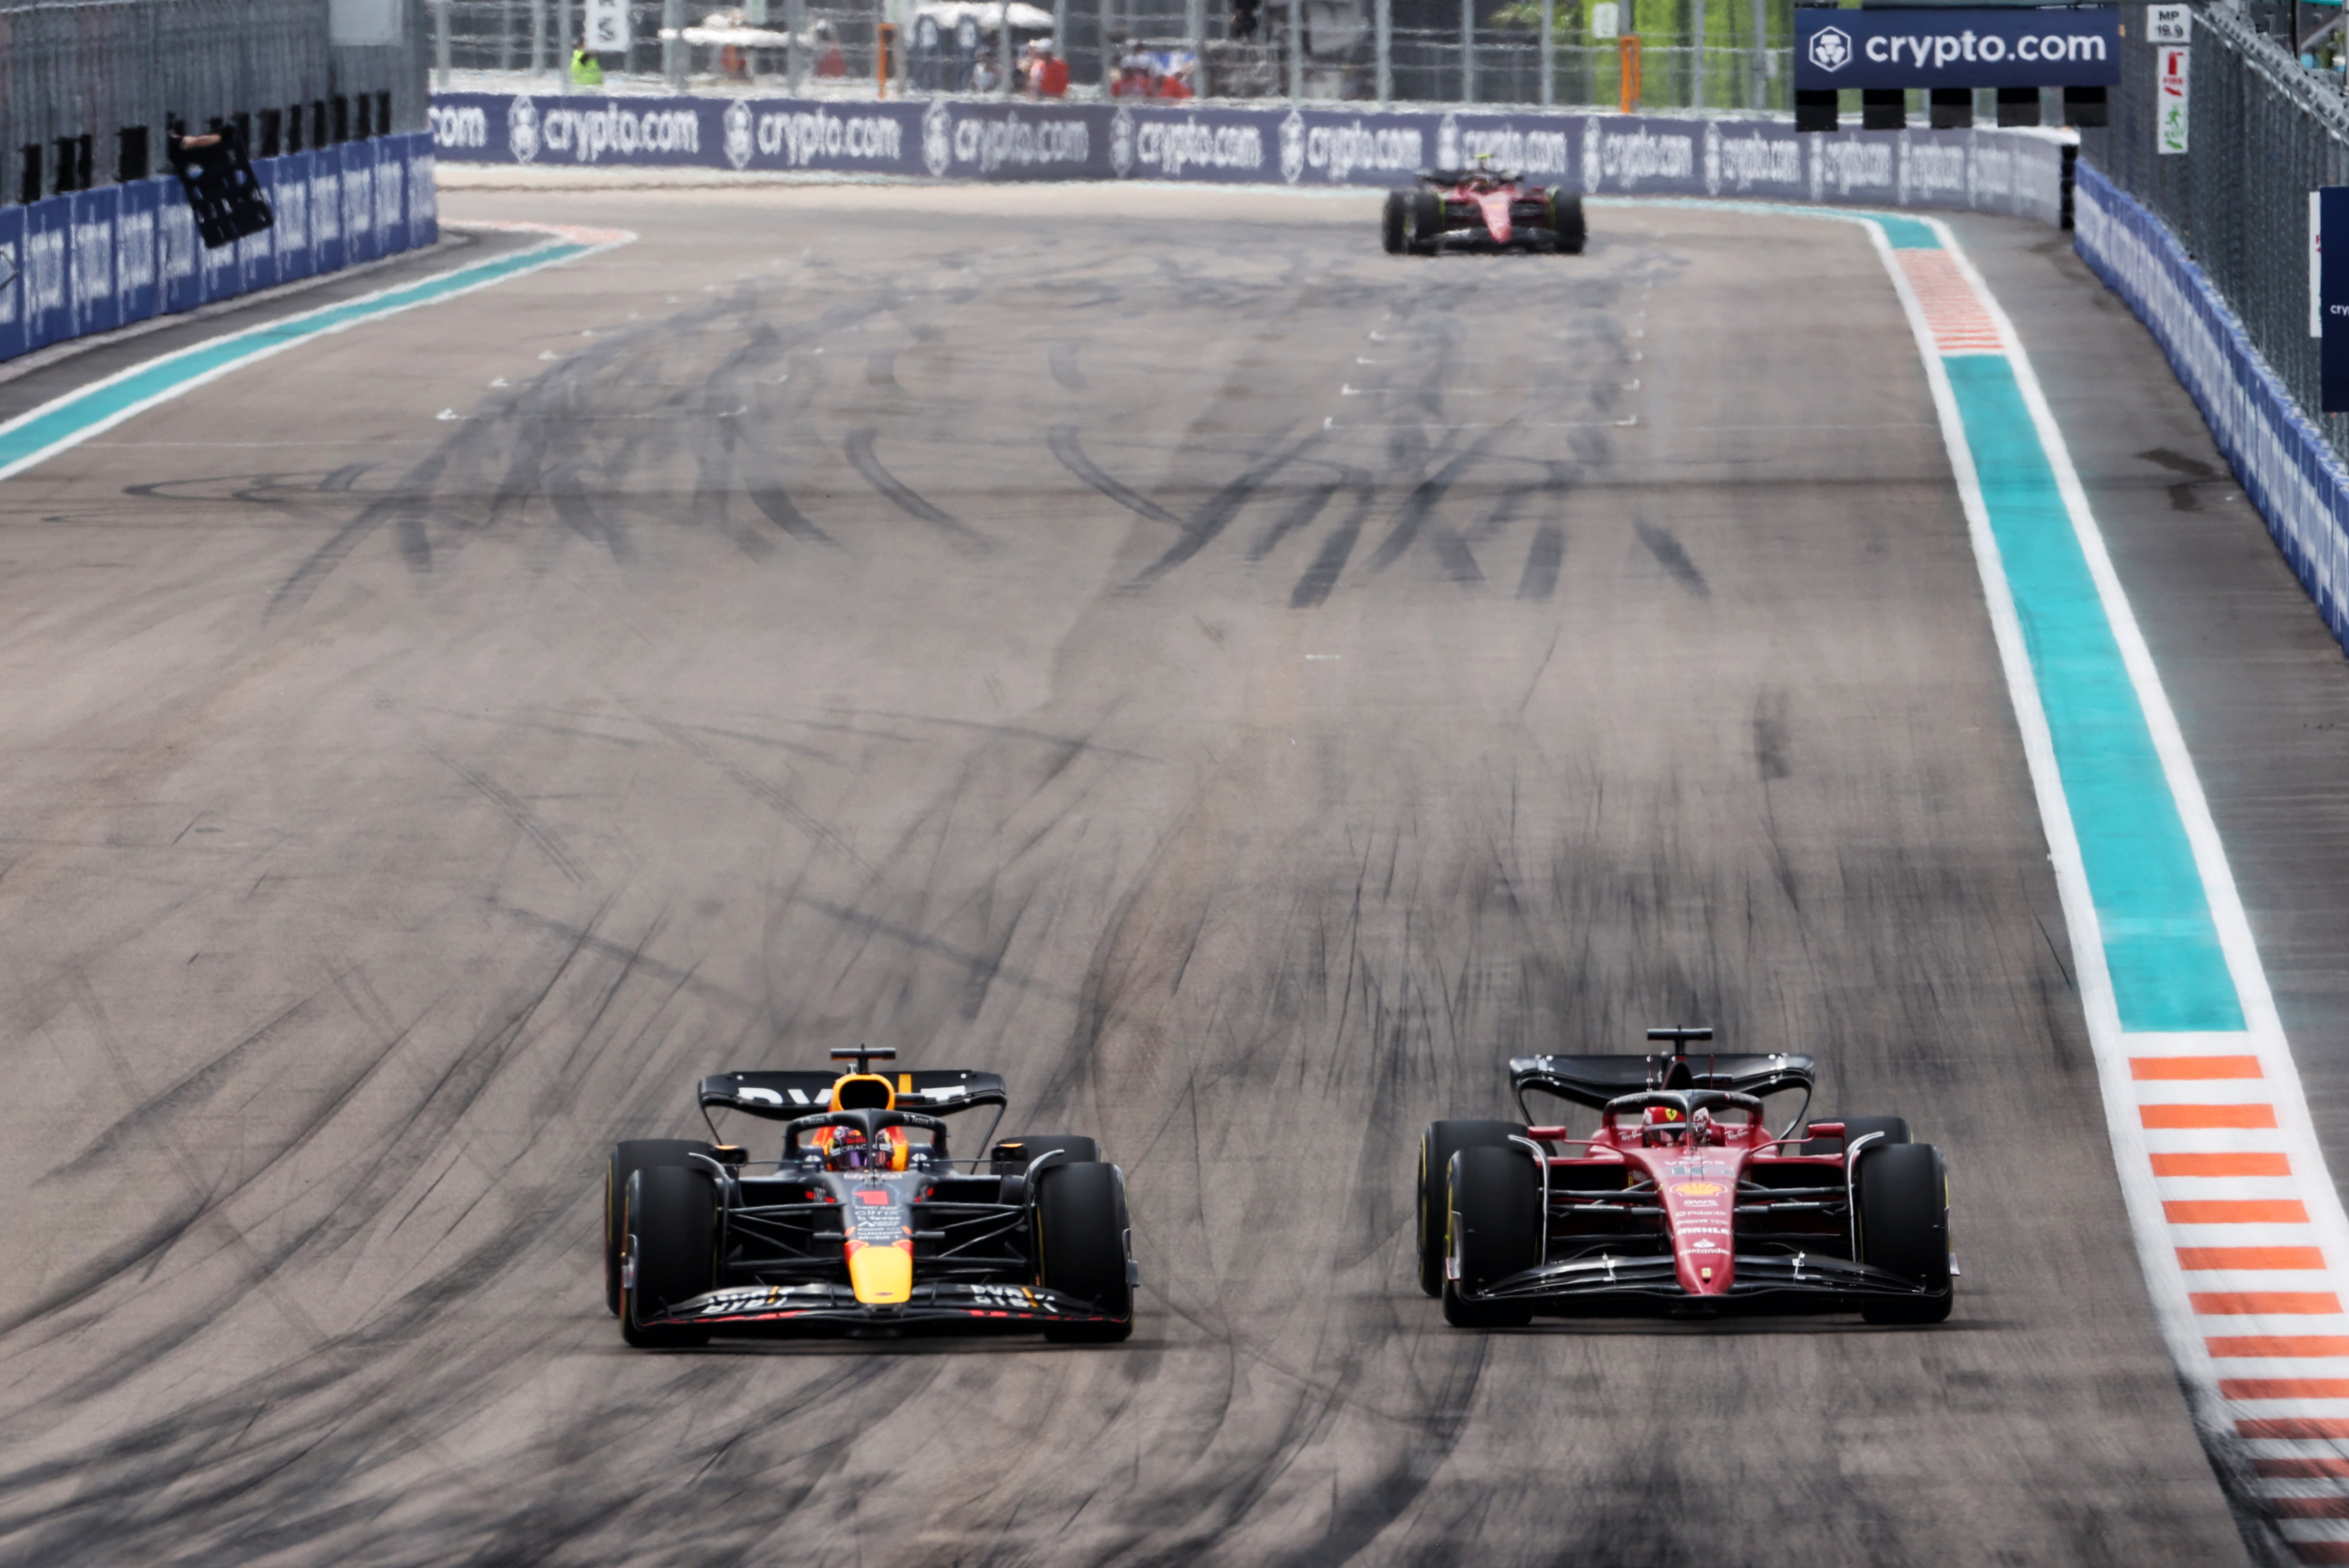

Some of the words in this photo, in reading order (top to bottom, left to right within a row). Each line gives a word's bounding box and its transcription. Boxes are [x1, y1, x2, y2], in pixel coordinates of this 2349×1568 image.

[2159, 10, 2180, 21] MP
[1865, 29, 2107, 68] crypto.com
[841, 1144, 878, 1152] ORACE
[1679, 1248, 1731, 1256] Santander
